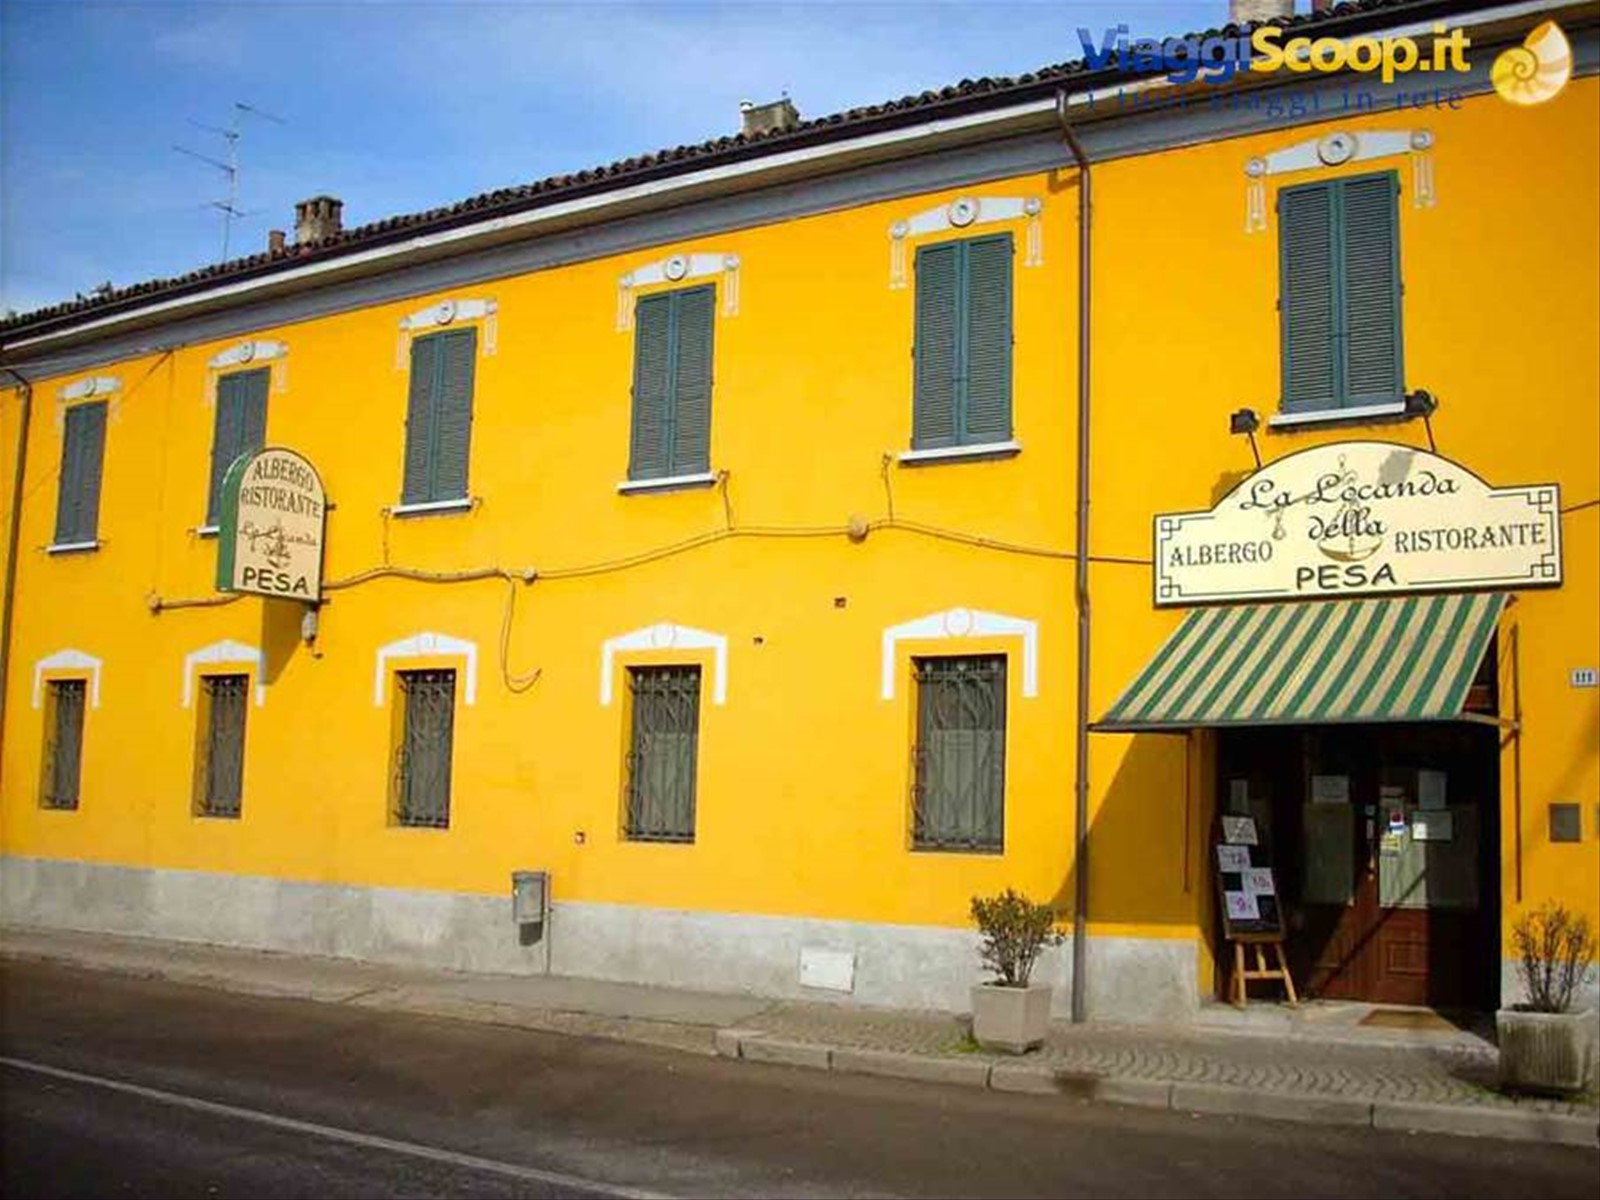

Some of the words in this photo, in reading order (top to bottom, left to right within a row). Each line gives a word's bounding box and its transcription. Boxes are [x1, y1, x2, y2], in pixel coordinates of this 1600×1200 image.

[252, 457, 314, 492] ALBERGO
[1240, 478, 1292, 510] La
[1305, 470, 1460, 504] Locanda
[240, 486, 322, 518] RISTORANTE
[1308, 505, 1387, 541] della
[1394, 522, 1546, 555] RISTORANTE
[1169, 539, 1274, 569] ALBERGO
[242, 566, 310, 595] PESA
[1296, 562, 1397, 590] PESA
